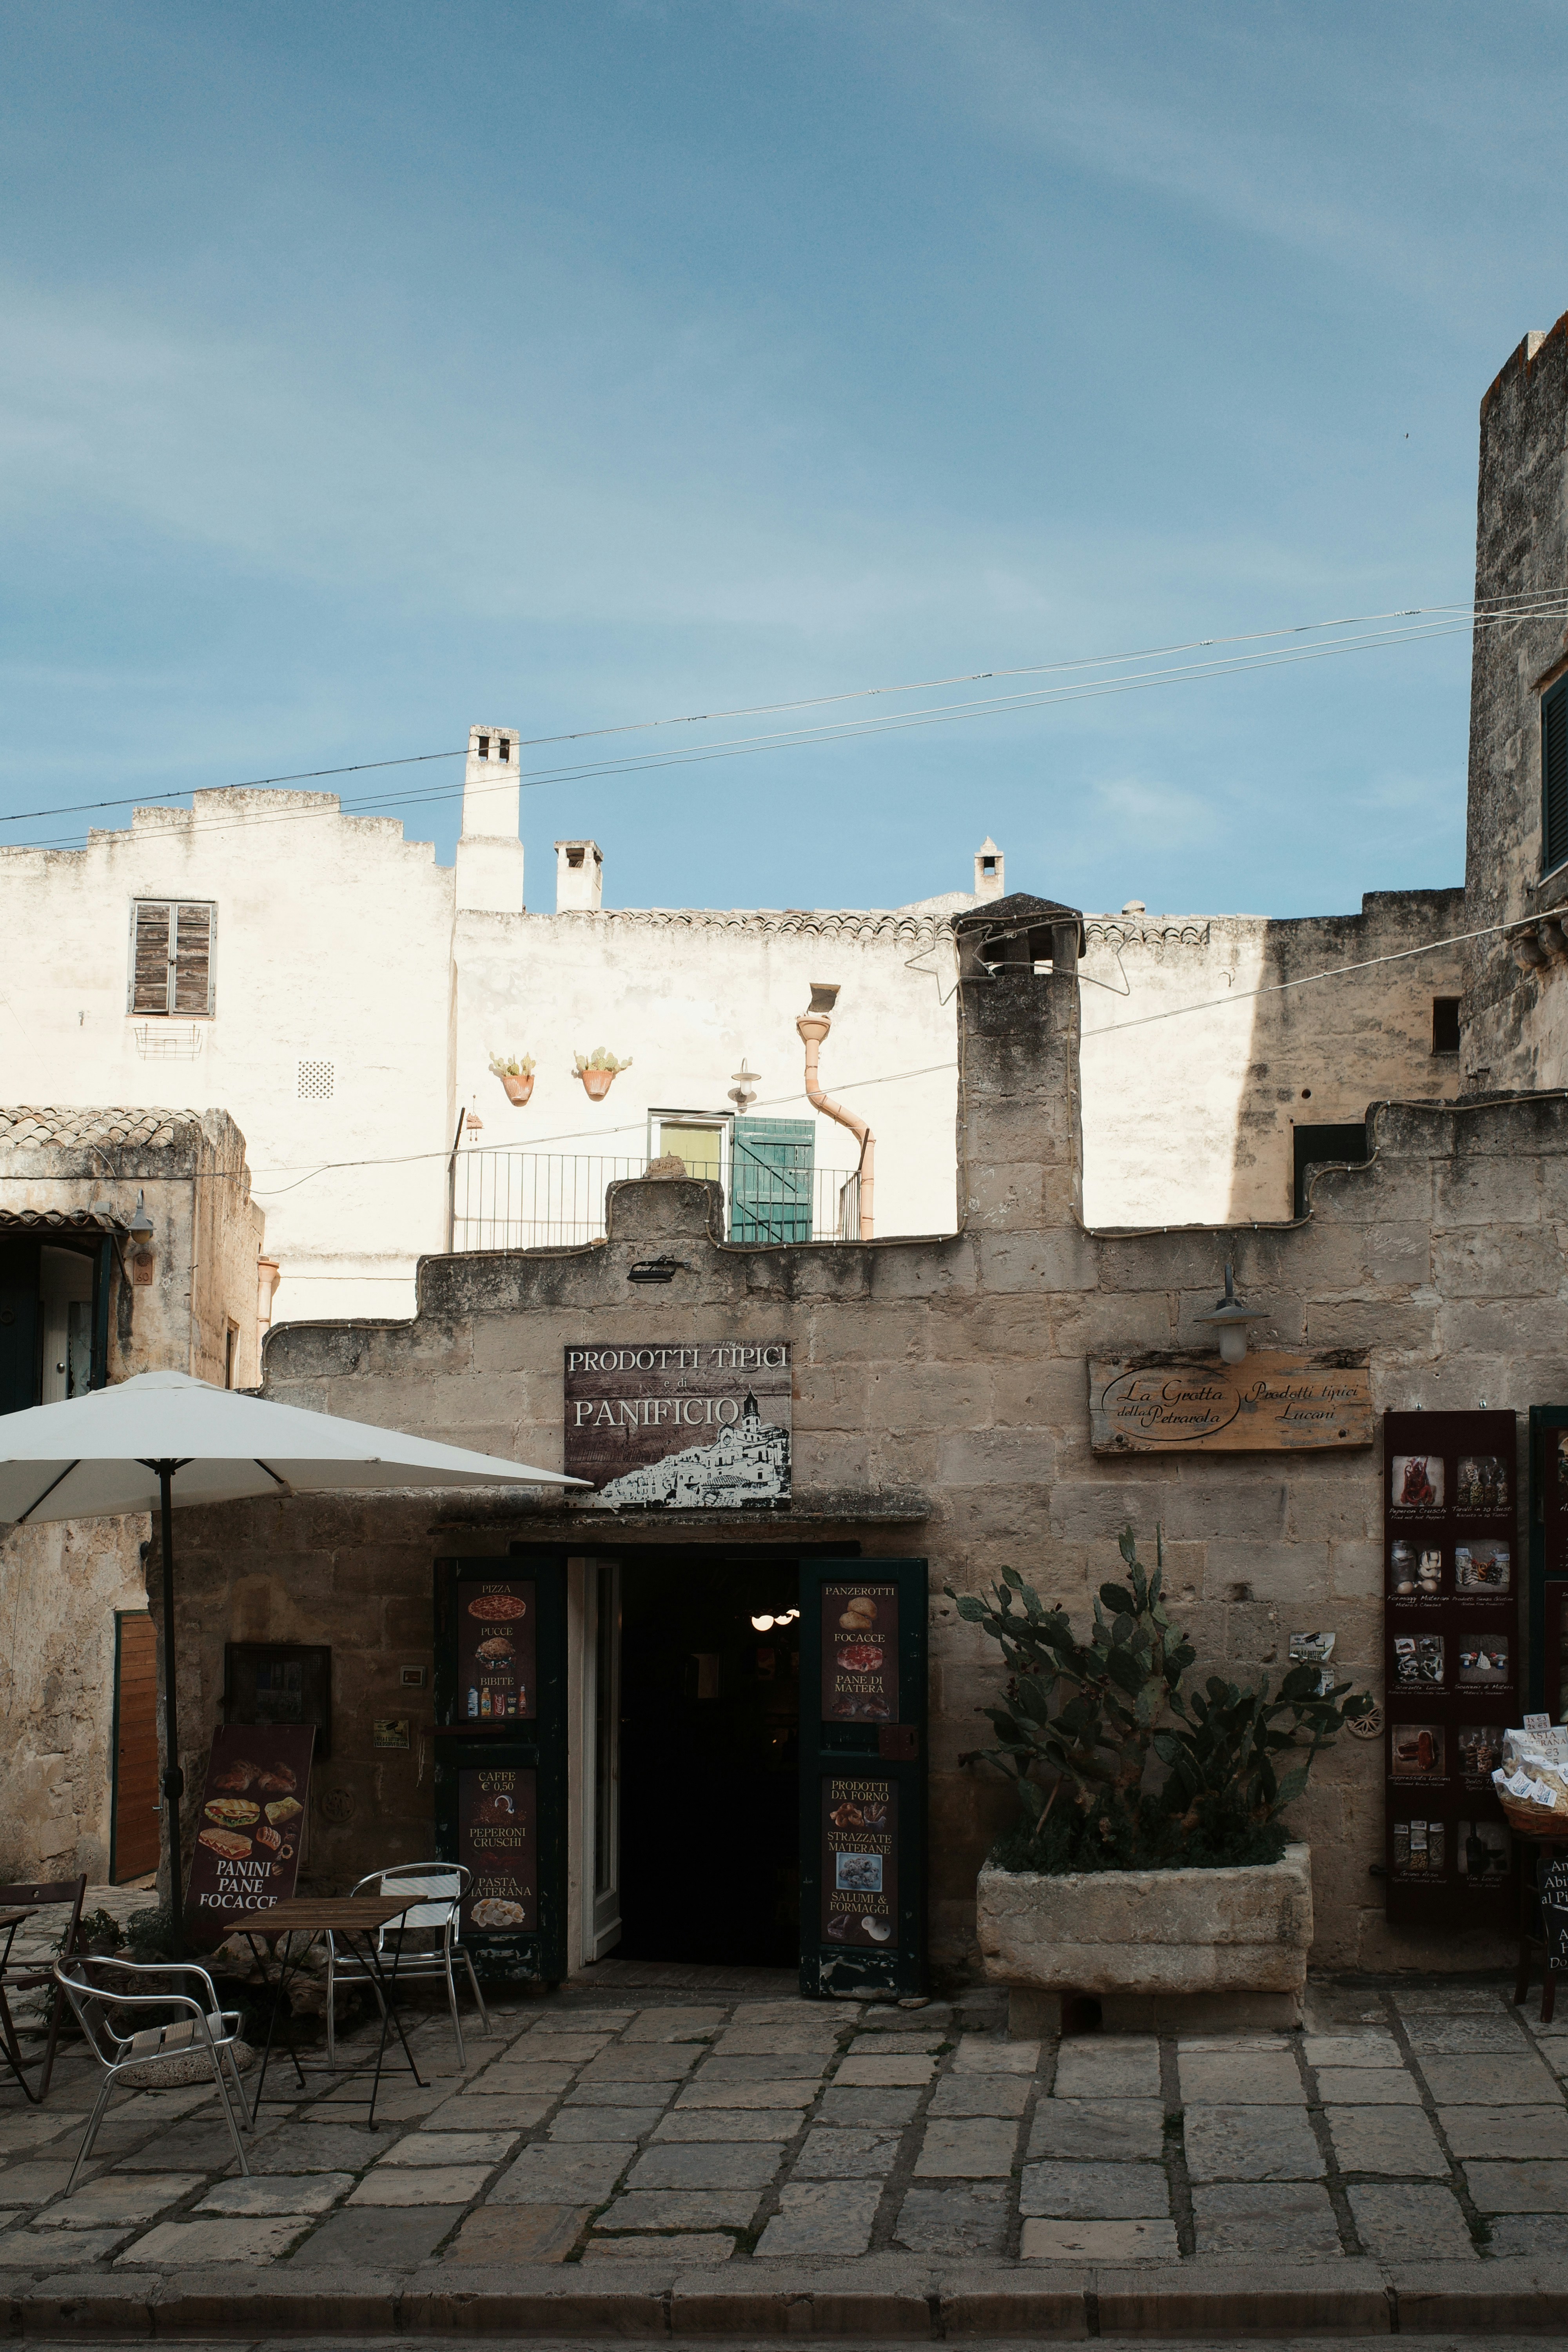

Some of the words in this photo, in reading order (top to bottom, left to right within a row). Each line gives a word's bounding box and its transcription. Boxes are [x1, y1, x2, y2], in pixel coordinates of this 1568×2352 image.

[137, 1272, 149, 1281] 60
[568, 1349, 700, 1371] PRODOTTI
[711, 1347, 789, 1368] TIPICI
[677, 1377, 687, 1388] di
[1116, 1380, 1152, 1402] La
[1162, 1379, 1224, 1407] Grotta
[1245, 1381, 1314, 1403] Prodotti
[1321, 1385, 1359, 1403] tipici
[573, 1398, 739, 1426] PANIFICIO
[1117, 1405, 1146, 1416] della
[1140, 1405, 1221, 1427] Petrarola
[1274, 1402, 1336, 1421] Lucani
[482, 1584, 511, 1593] PIZZA
[825, 1587, 895, 1595] PANZEROTTI
[1387, 1594, 1418, 1603] Formaggi
[481, 1627, 513, 1636] PUCCE
[834, 1633, 885, 1642] FOCACCE
[480, 1677, 514, 1686] BIBITE
[837, 1675, 867, 1684] PANE
[871, 1676, 883, 1684] DI
[835, 1684, 884, 1693] MATERA
[1530, 1731, 1557, 1739] ASTA
[1545, 1748, 1559, 1757] €3
[478, 1771, 516, 1781] CAFFE
[481, 1782, 490, 1791] €
[494, 1782, 514, 1793] 0,50
[831, 1780, 889, 1792] PRODOTTI
[831, 1790, 848, 1800] DA
[851, 1791, 889, 1802] FORNO
[470, 1828, 526, 1838] PEPERONI
[827, 1831, 892, 1844] STRAZZATE
[474, 1837, 522, 1847] CRUSCHI
[828, 1842, 891, 1855] MATERANE
[216, 1860, 272, 1877] PANINI
[218, 1878, 264, 1893] PANE
[478, 1877, 517, 1887] PASTA
[1544, 1875, 1568, 1888] Abi
[831, 1891, 874, 1904] SALUMI
[878, 1895, 887, 1904] &
[1541, 1892, 1552, 1904] al
[829, 1901, 889, 1915] FORMAGGI
